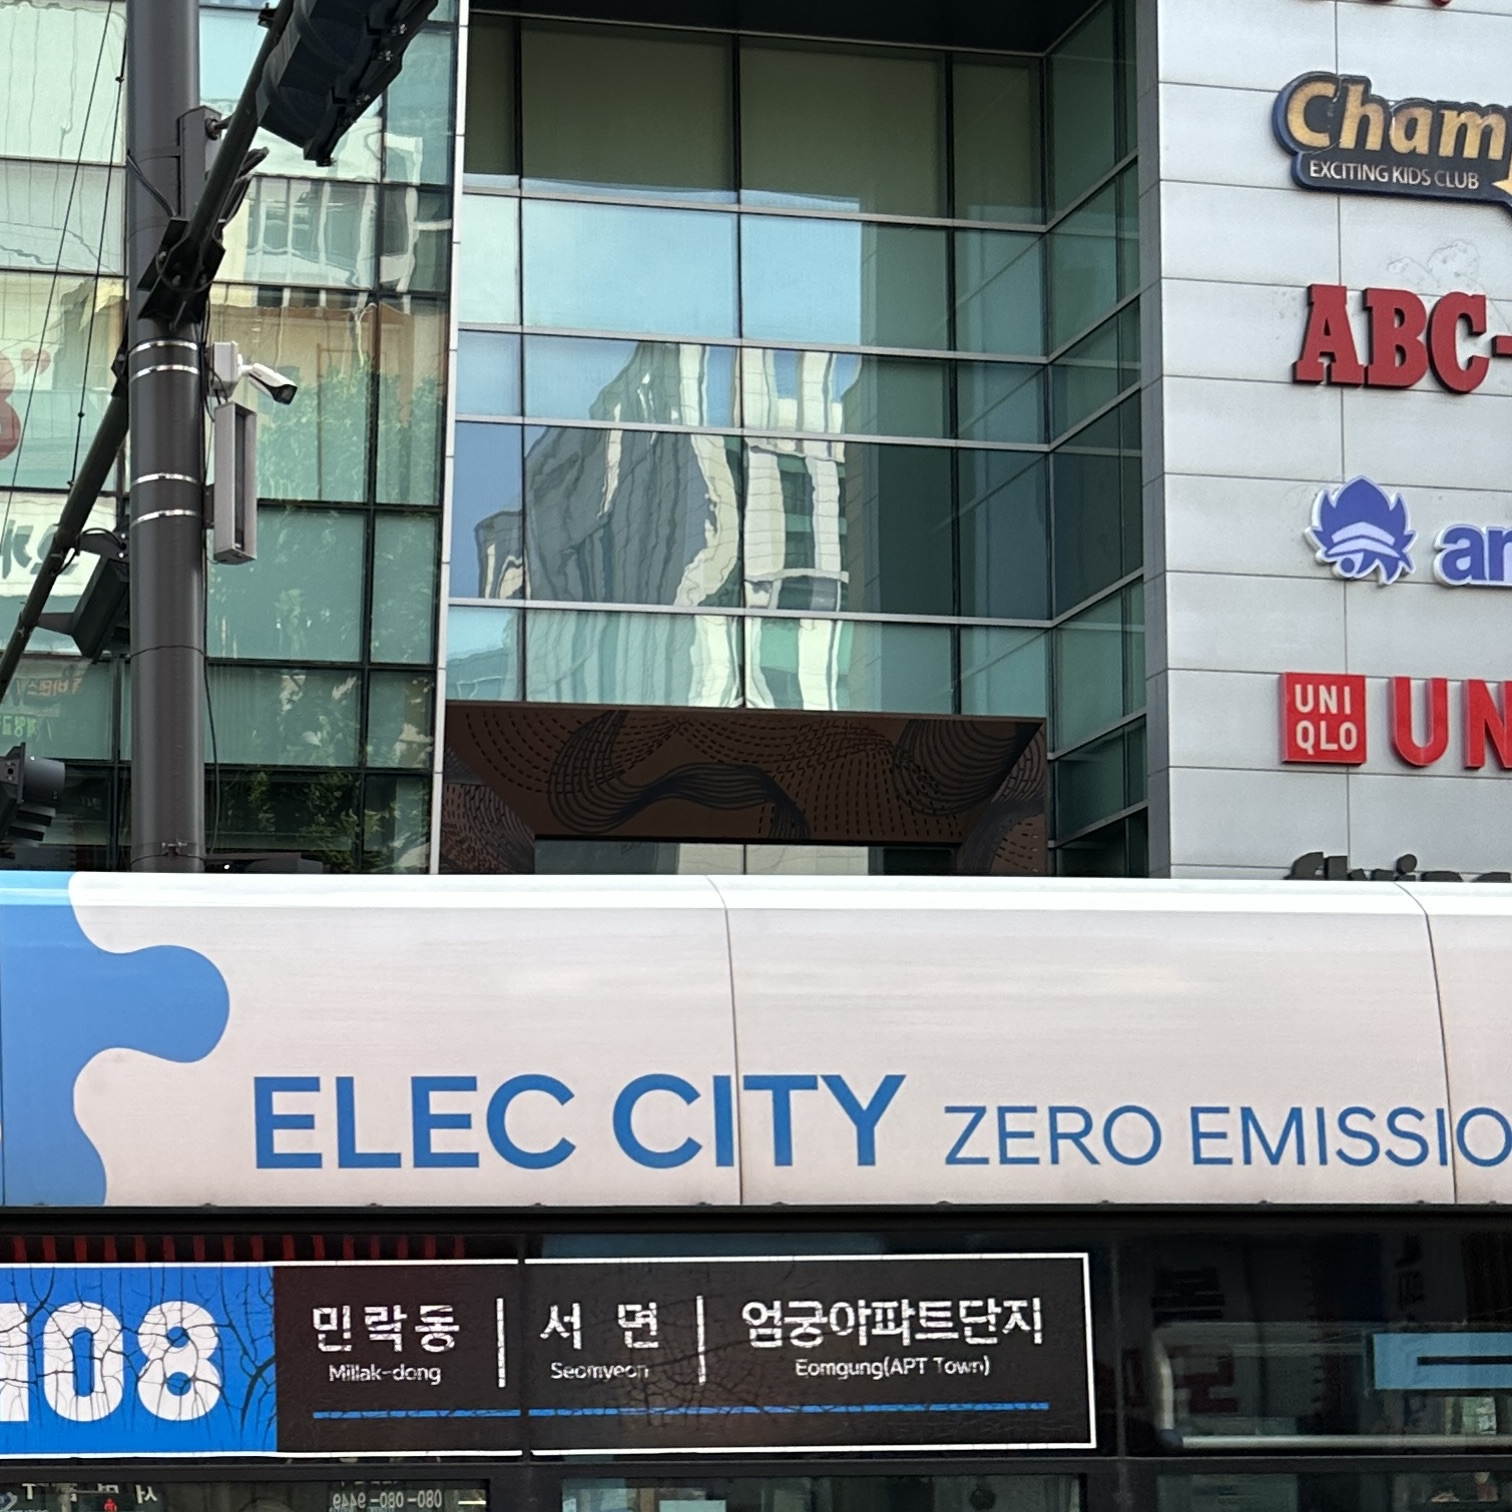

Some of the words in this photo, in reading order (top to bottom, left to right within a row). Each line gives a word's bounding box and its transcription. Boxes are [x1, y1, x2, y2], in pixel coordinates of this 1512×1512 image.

[1310, 159, 1389, 183] EXCITING
[1392, 167, 1432, 187] KIDS
[1434, 170, 1480, 190] CLUB
[1294, 684, 1352, 715] UNI
[1294, 720, 1357, 754] QLO
[254, 1073, 576, 1170] ELEC
[613, 1072, 907, 1169] CITY
[945, 1104, 1163, 1168] ZERO
[1194, 1104, 1512, 1168] EMISSIO
[312, 1303, 461, 1354] 민락동
[741, 1296, 1045, 1350] 엄궁아파트단지
[327, 1361, 443, 1386] Millak-dong
